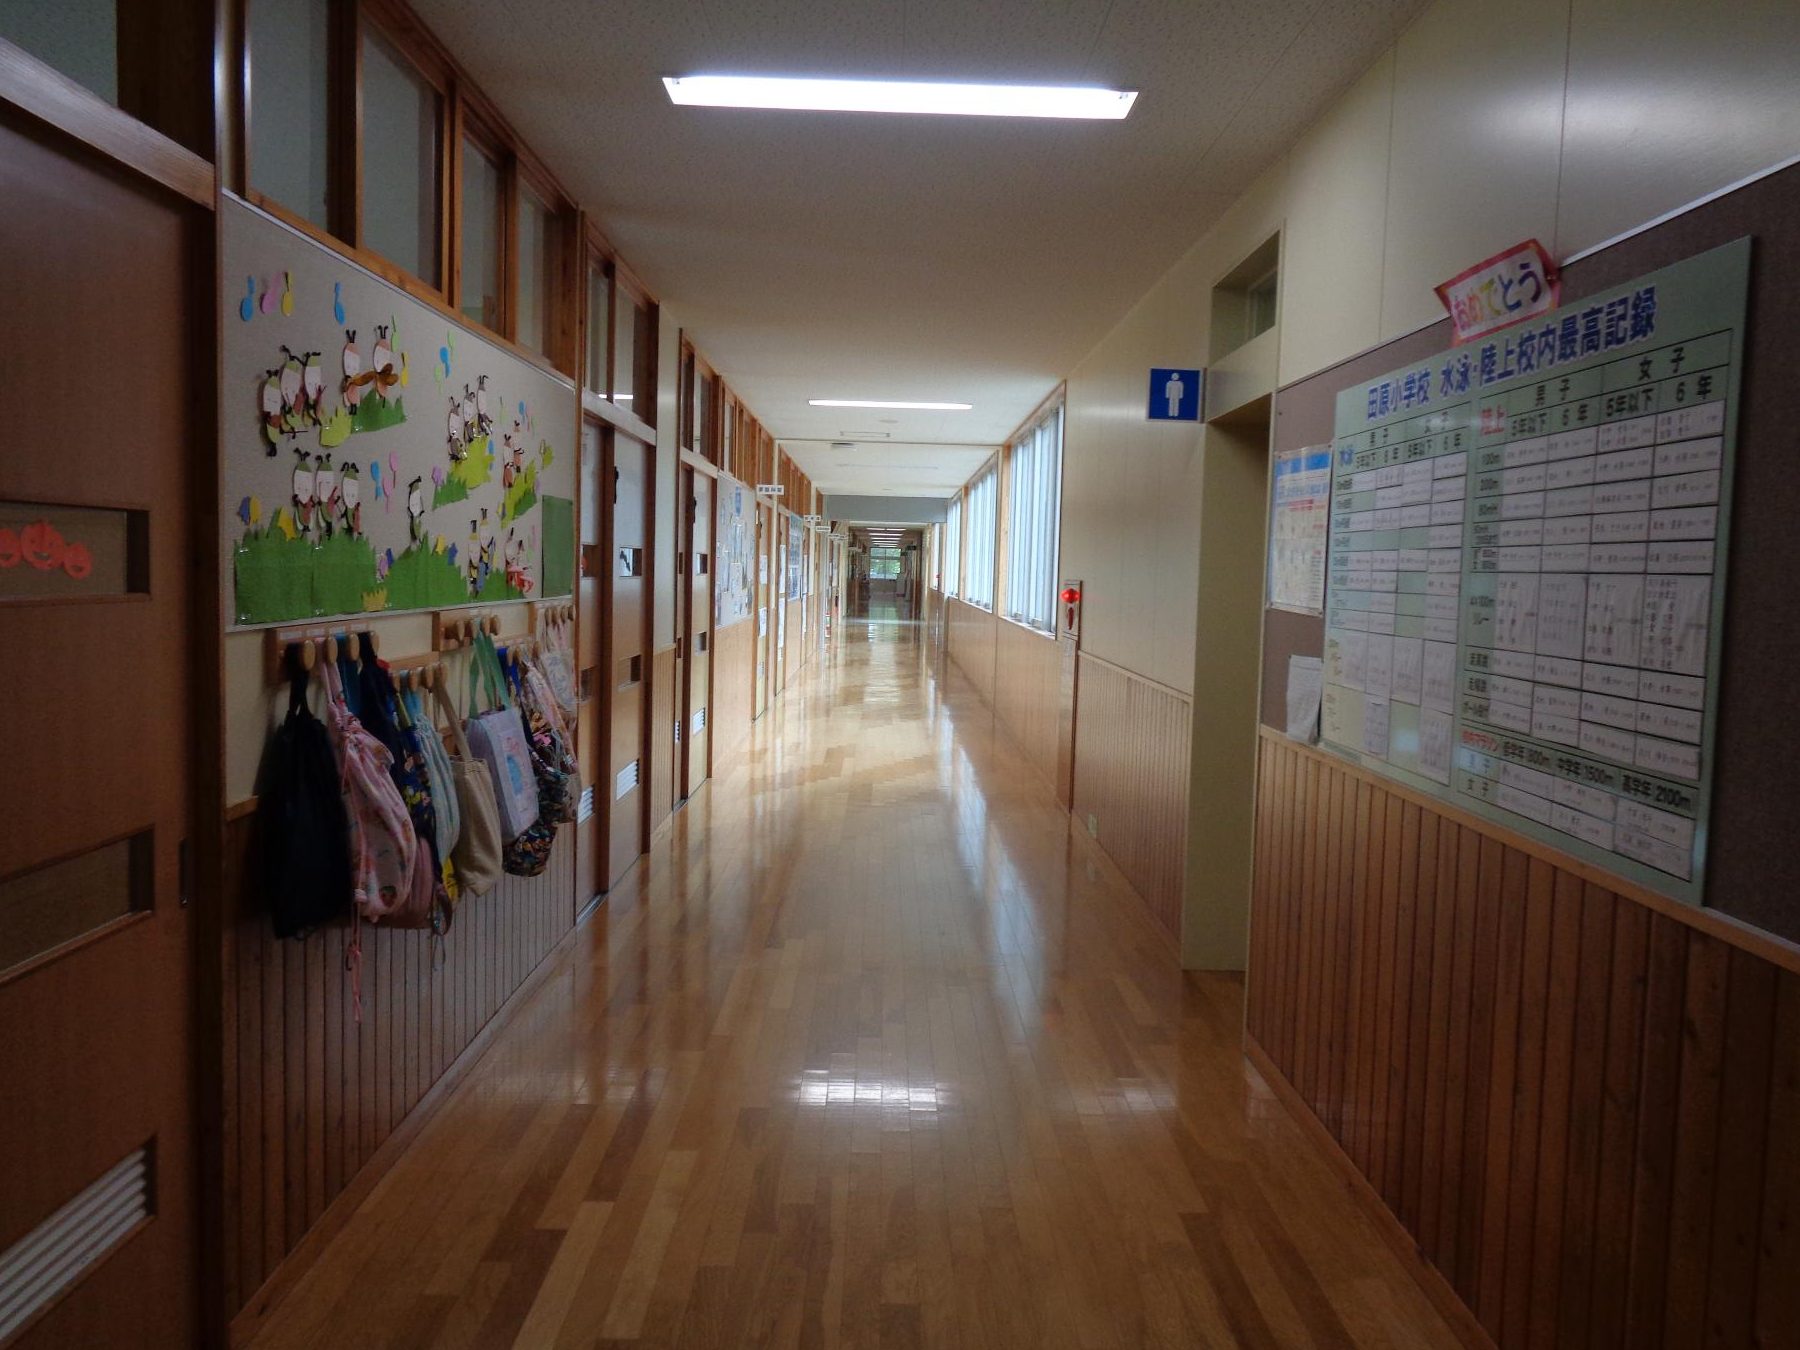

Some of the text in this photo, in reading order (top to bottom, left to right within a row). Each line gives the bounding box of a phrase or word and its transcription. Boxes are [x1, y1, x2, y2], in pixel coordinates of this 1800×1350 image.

[1453, 261, 1541, 330] おめでとう
[1367, 367, 1432, 420] 田原小学校
[1604, 387, 1655, 417] 5年以下
